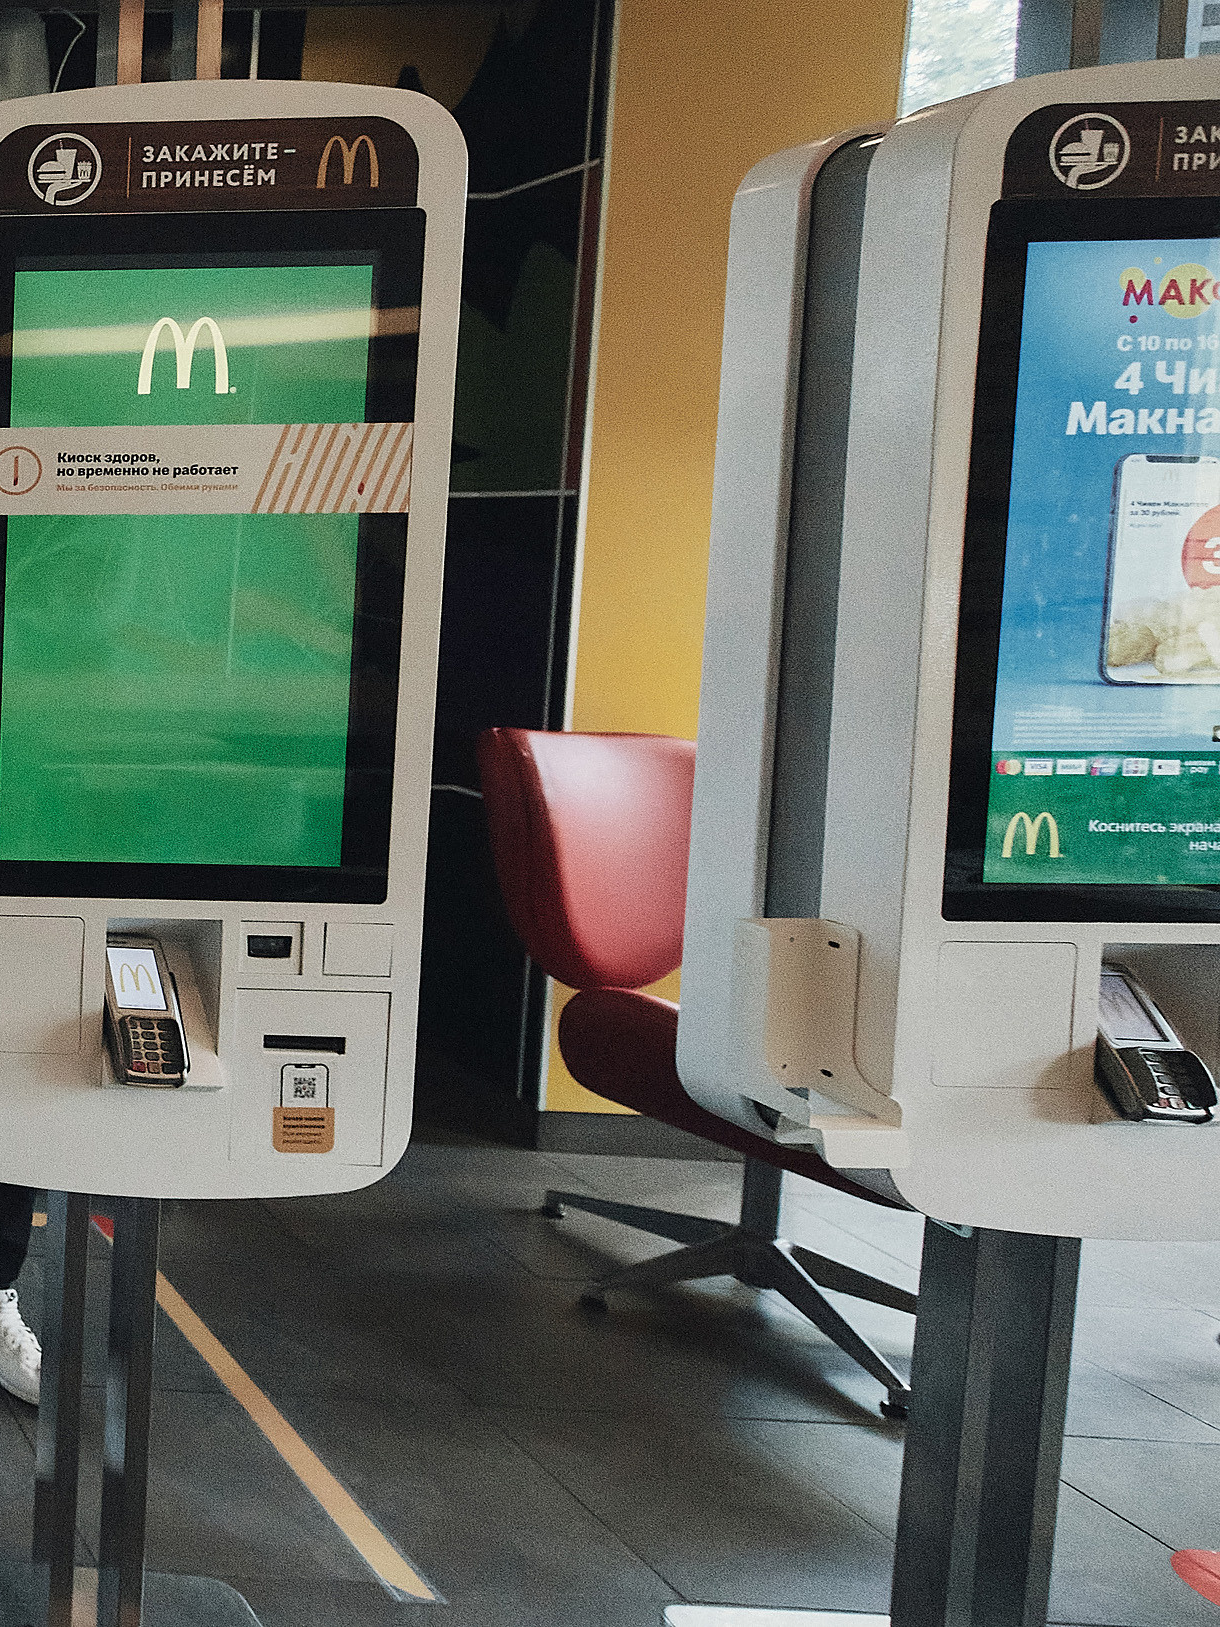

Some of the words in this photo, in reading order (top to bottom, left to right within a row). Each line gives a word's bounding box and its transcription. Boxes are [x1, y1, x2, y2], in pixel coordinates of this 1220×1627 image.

[142, 165, 276, 188] ПРИНЕСЁМ
[1137, 335, 1161, 351] 10
[1164, 337, 1193, 351] по
[1114, 361, 1145, 395] 4
[1155, 360, 1218, 395] Чи
[1065, 400, 1220, 435] Макна
[58, 452, 102, 463] Киоск
[105, 453, 160, 465] здоров,
[57, 467, 75, 476] но
[78, 467, 149, 479] временно
[152, 466, 170, 476] не
[173, 464, 239, 478] работает
[1088, 819, 1167, 833] Коснитесь
